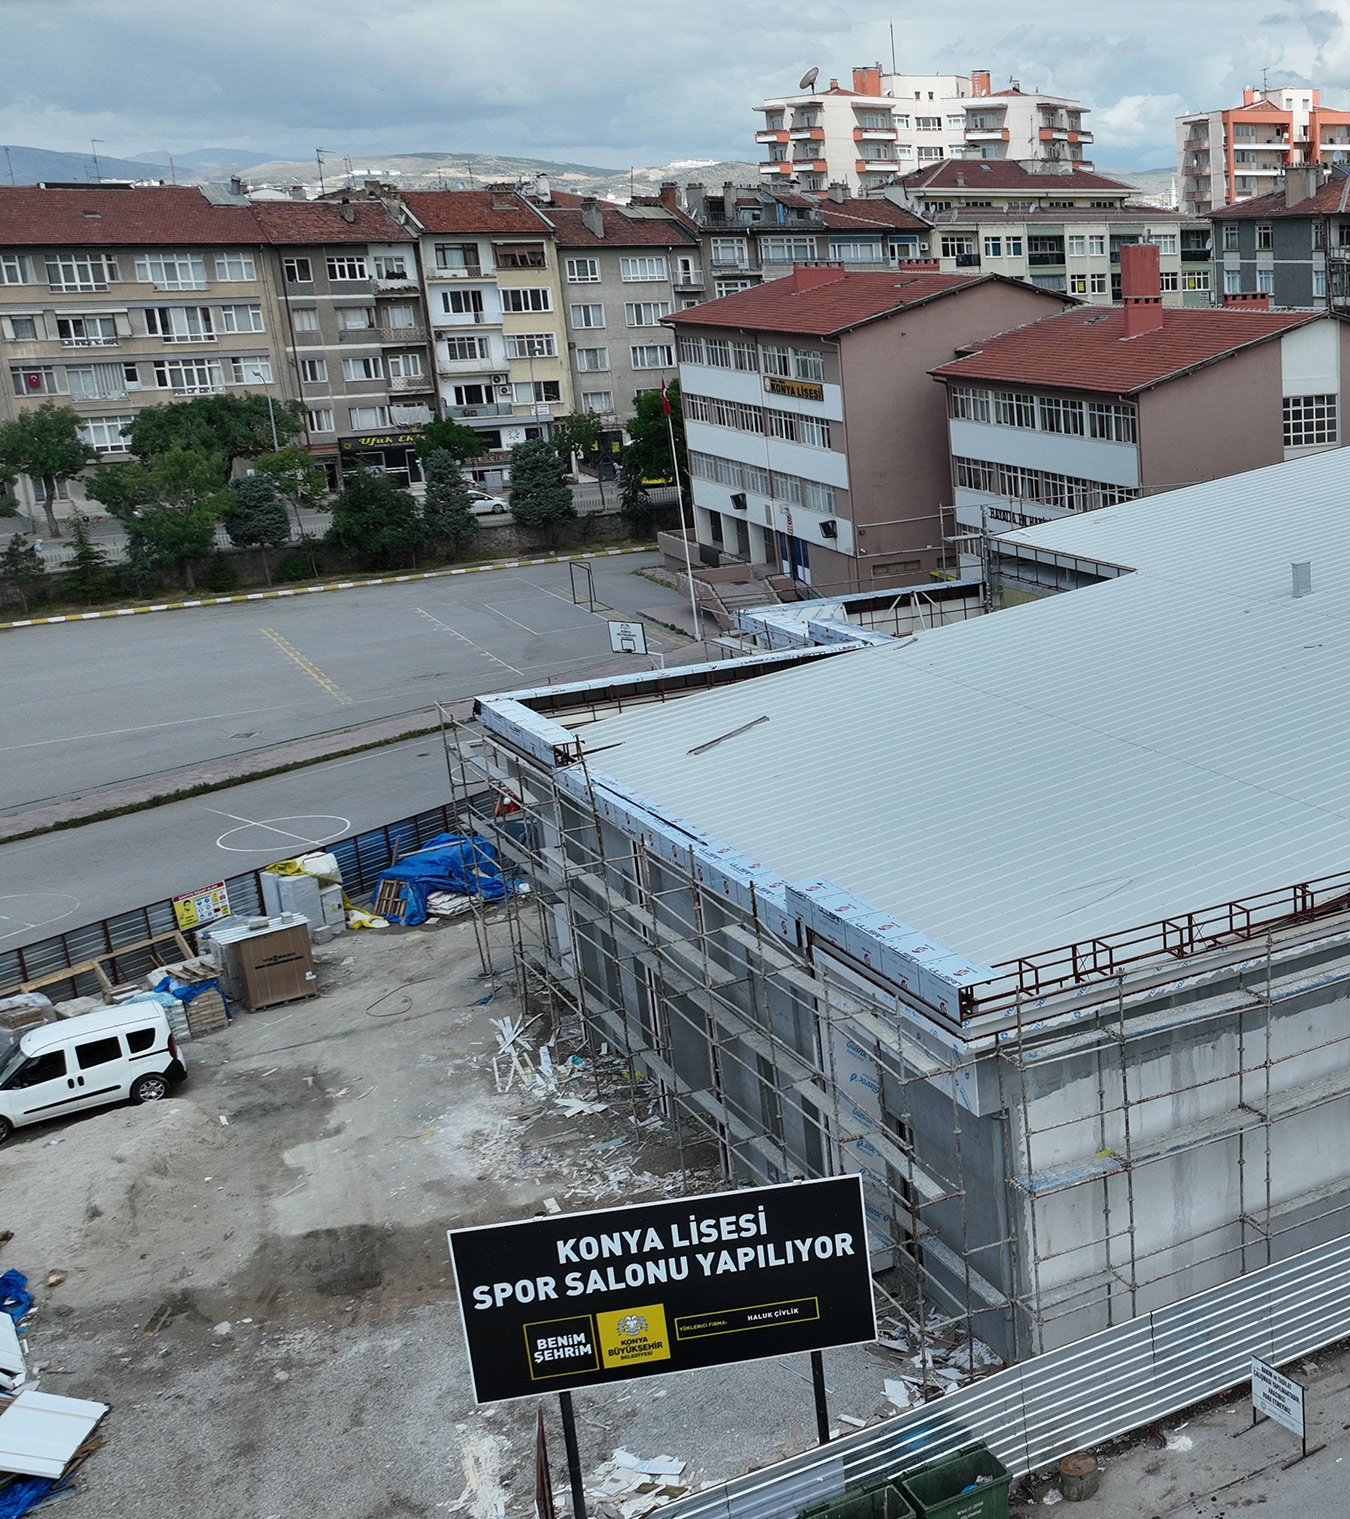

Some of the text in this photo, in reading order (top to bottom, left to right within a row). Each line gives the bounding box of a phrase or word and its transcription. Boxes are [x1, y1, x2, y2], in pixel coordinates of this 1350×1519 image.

[771, 382, 821, 400] KONYA LİSESİ
[557, 1204, 768, 1265] KONYA LİSESİ
[472, 1232, 855, 1311] SPOR SALONU YAPILIYOR
[747, 1307, 799, 1322] HALUK ÇİVLİK
[607, 1341, 664, 1357] BÜYÜKŞEHİR
[620, 1336, 649, 1346] KONYA
[620, 1351, 653, 1360] BELEDİYESİ
